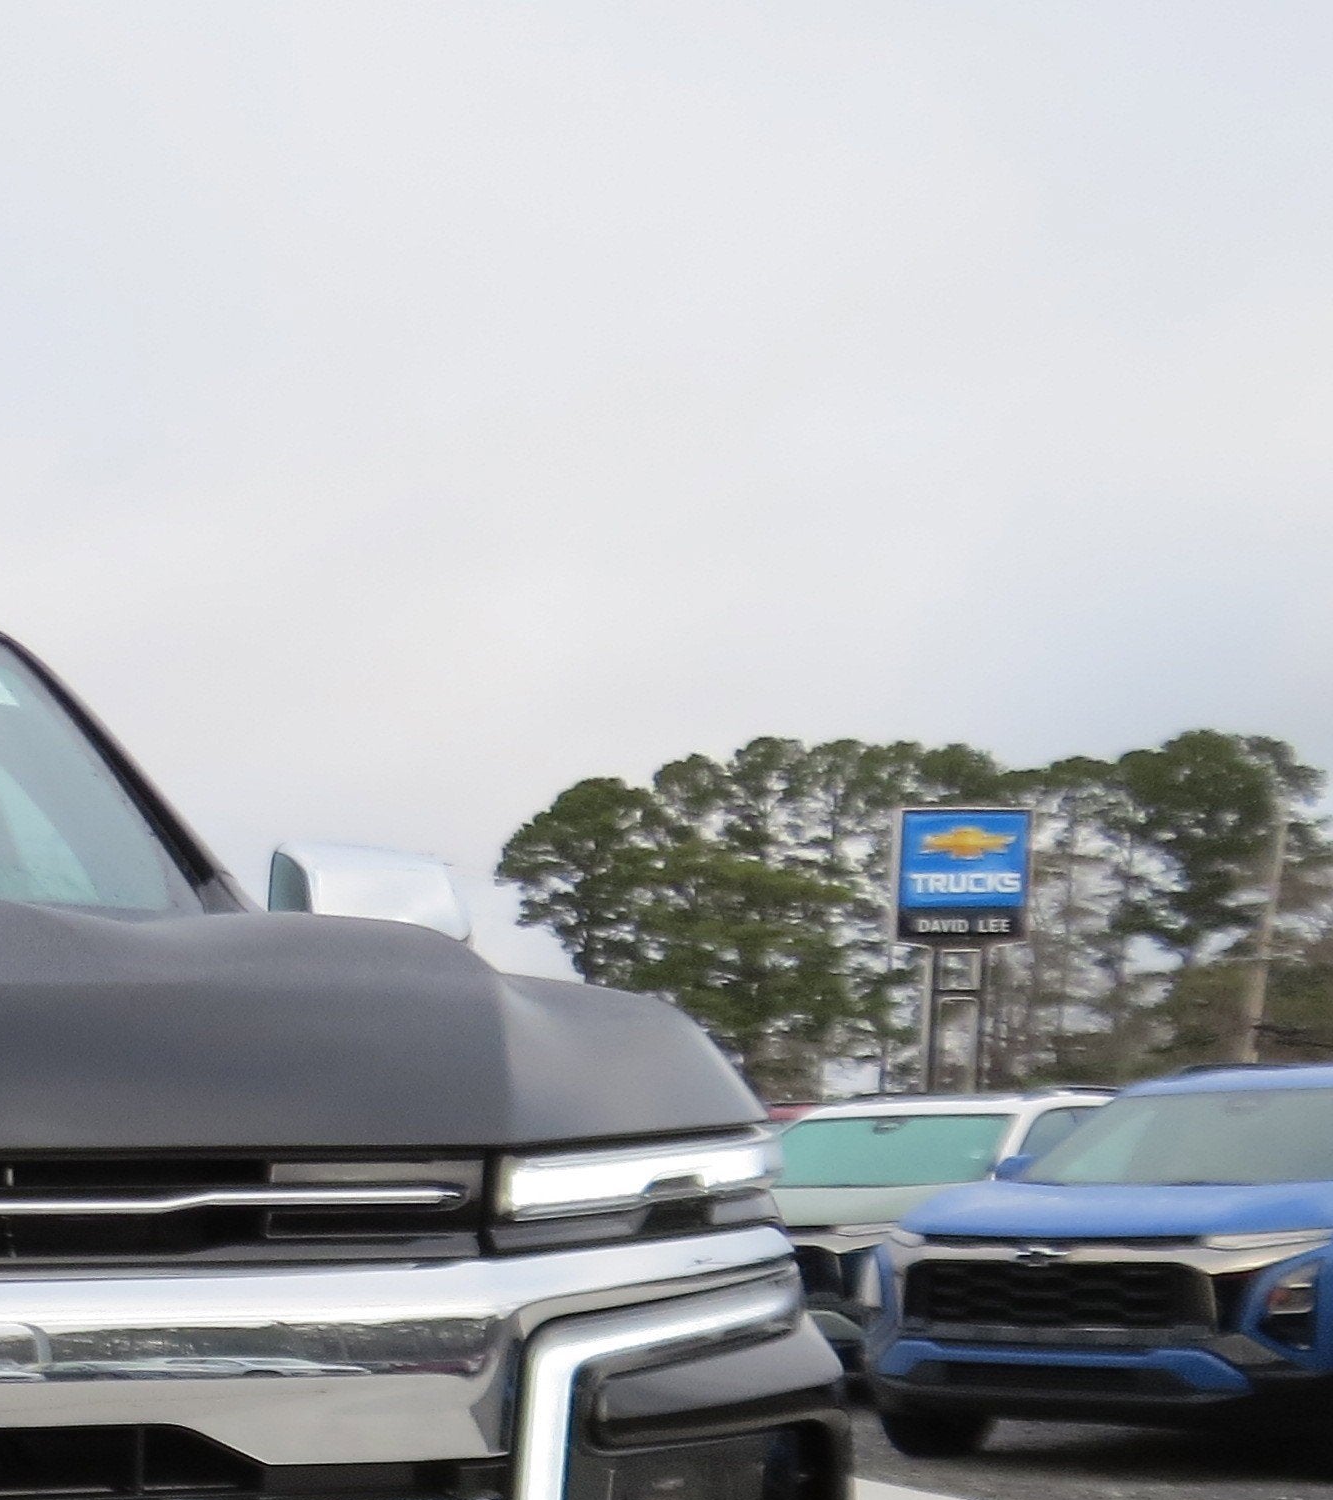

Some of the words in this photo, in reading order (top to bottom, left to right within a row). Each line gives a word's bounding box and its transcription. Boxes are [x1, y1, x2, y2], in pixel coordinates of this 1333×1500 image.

[909, 873, 1022, 894] TRUCKS
[918, 919, 969, 933] DAVID
[978, 919, 1011, 933] LEE
